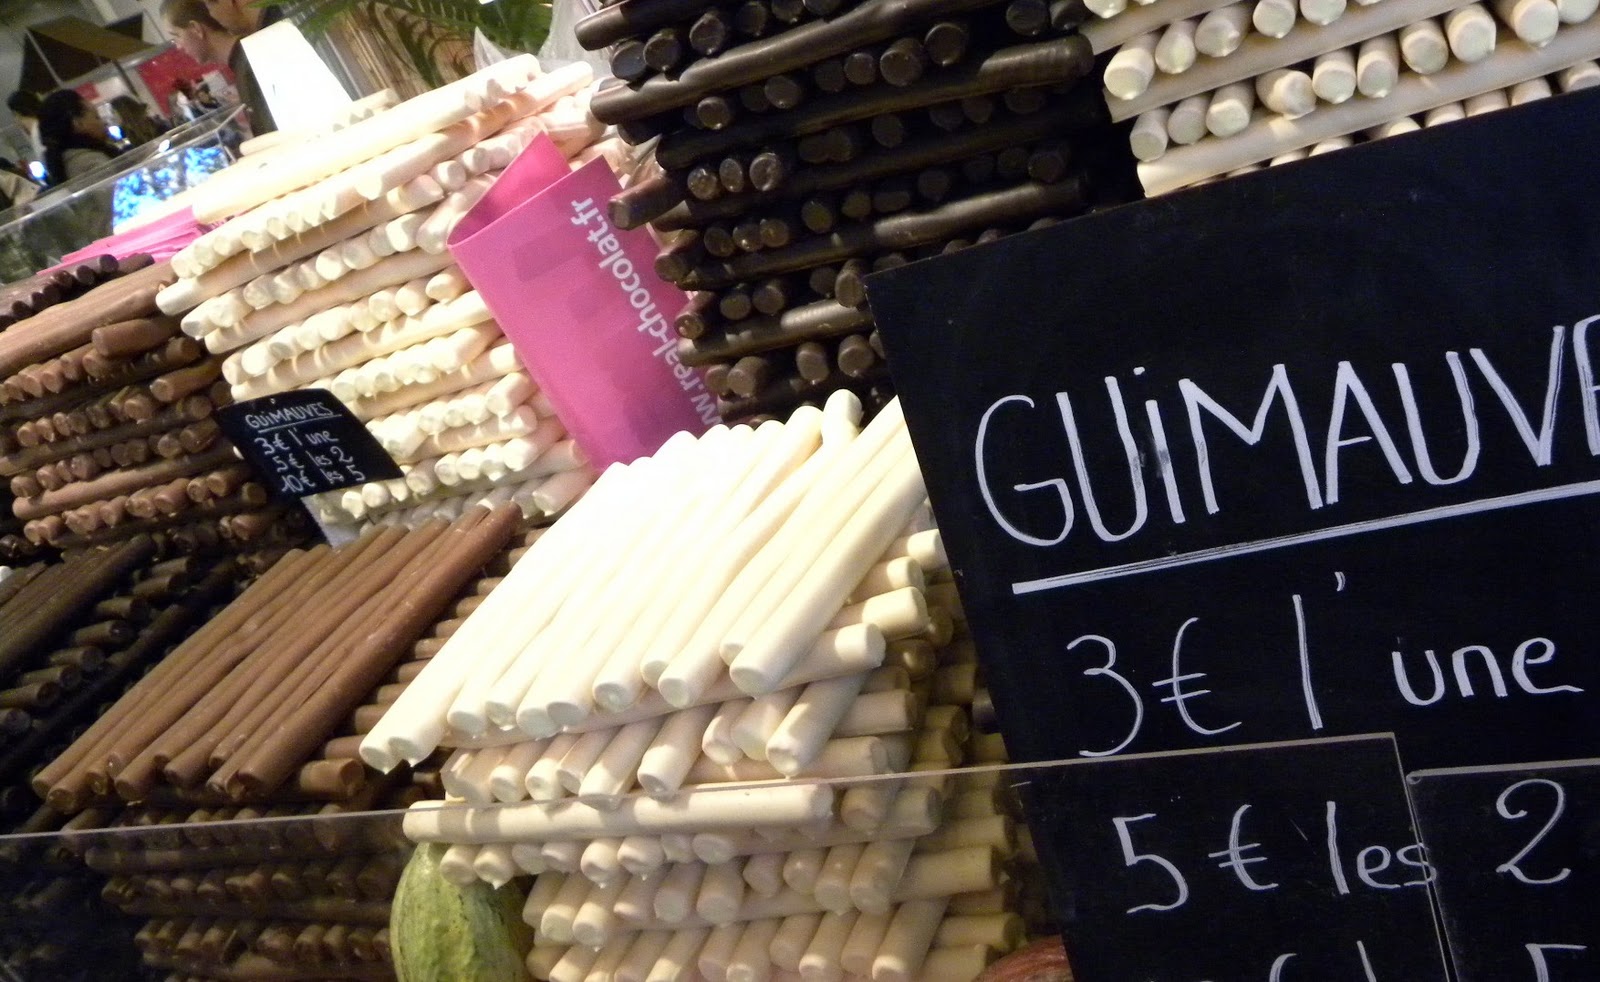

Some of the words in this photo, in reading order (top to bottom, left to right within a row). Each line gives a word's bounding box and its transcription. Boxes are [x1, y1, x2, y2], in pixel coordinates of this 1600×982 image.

[305, 430, 339, 445] une
[305, 450, 332, 467] les
[330, 446, 353, 463] 2
[347, 464, 366, 482] 5
[1392, 637, 1584, 705] une
[1326, 800, 1438, 895] les
[1495, 778, 1572, 884] 2
